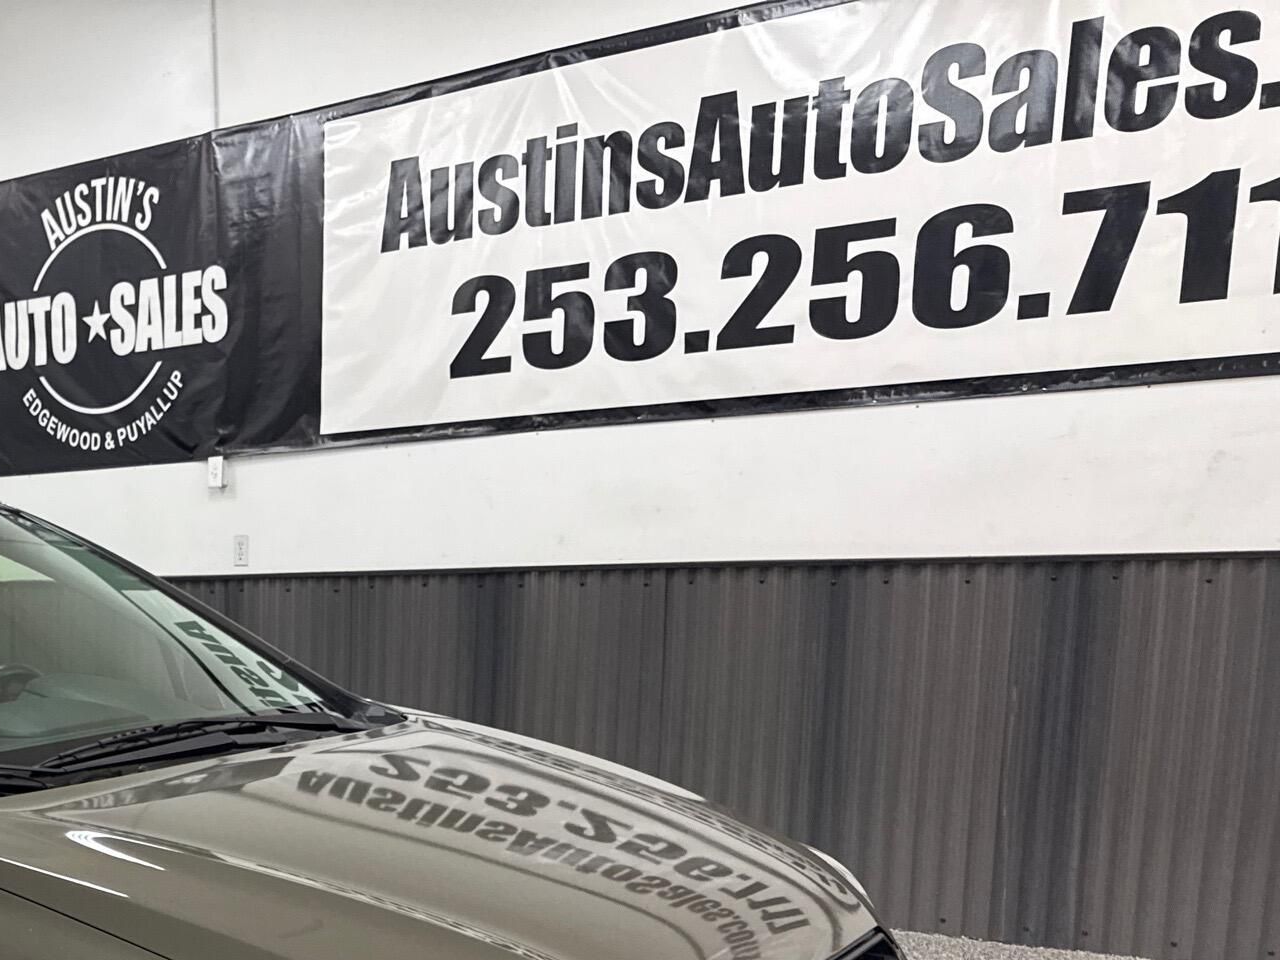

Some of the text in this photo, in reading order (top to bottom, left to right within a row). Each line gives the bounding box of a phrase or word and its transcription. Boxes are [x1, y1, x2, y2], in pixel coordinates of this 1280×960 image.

[40, 175, 160, 250] AUSTIN'S
[109, 265, 228, 356] SALES
[23, 370, 183, 451] EDGEWOOD & PUYALLUP
